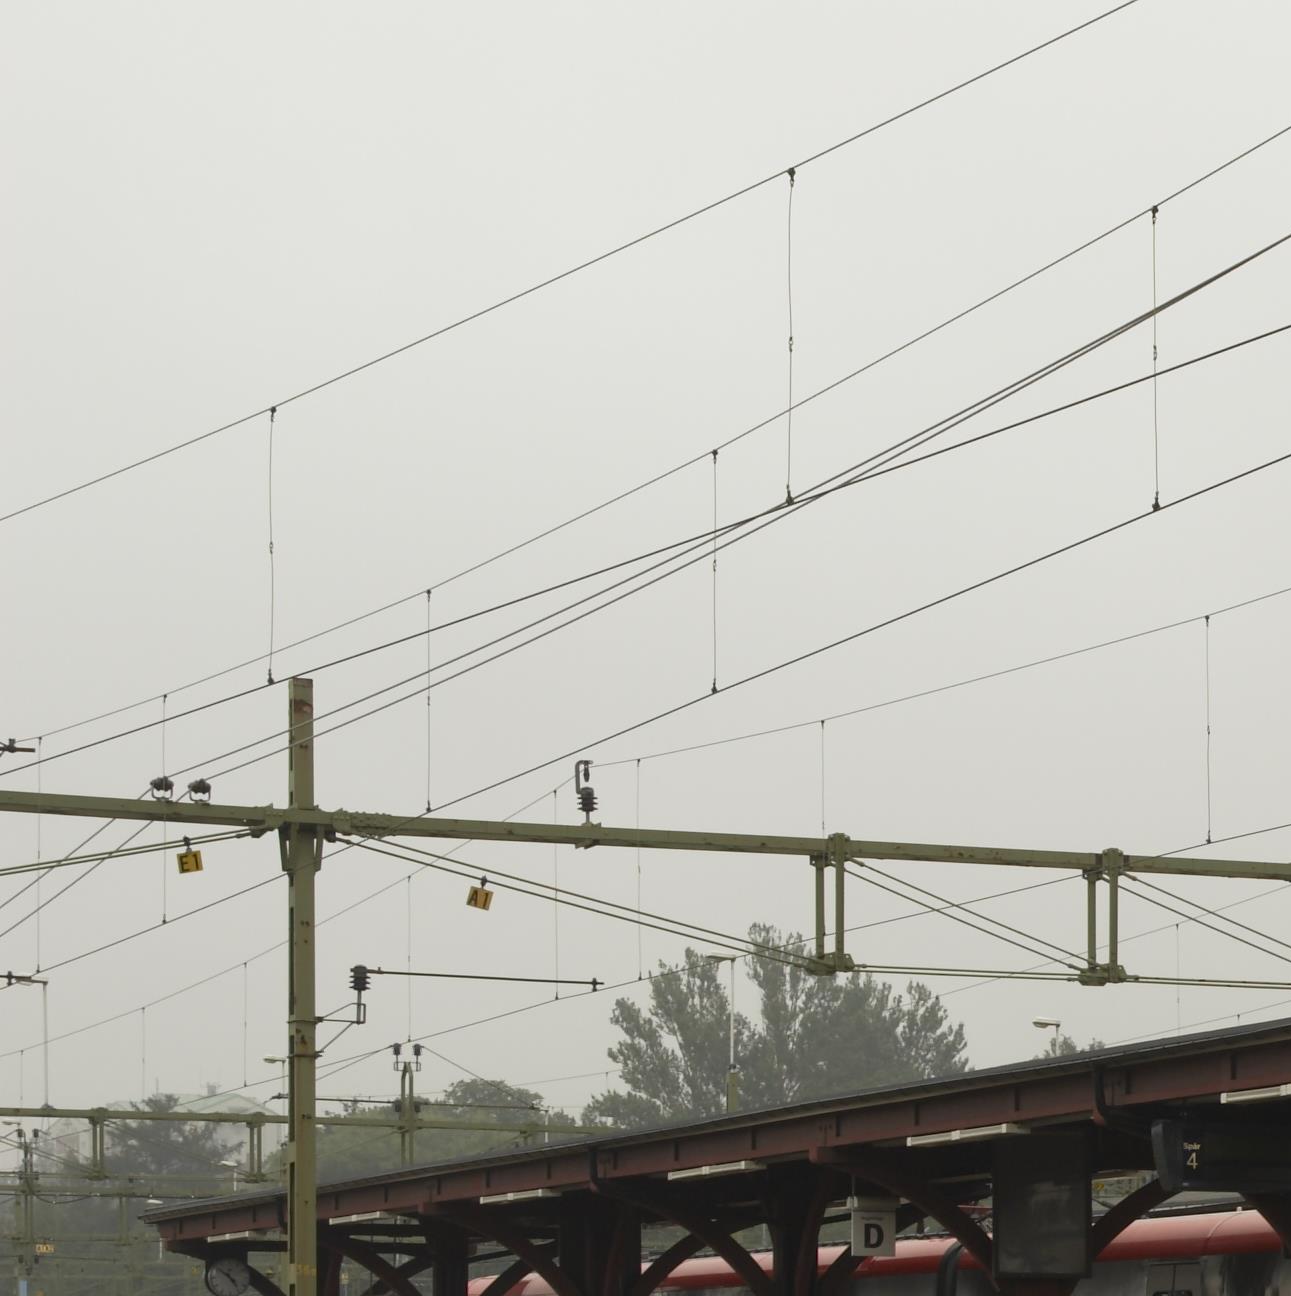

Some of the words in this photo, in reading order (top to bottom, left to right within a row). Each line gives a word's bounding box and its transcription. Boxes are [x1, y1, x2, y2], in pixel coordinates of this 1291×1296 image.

[180, 853, 200, 872] E1
[467, 889, 489, 908] A1
[1186, 1151, 1199, 1170] 4
[864, 1223, 884, 1249] D
